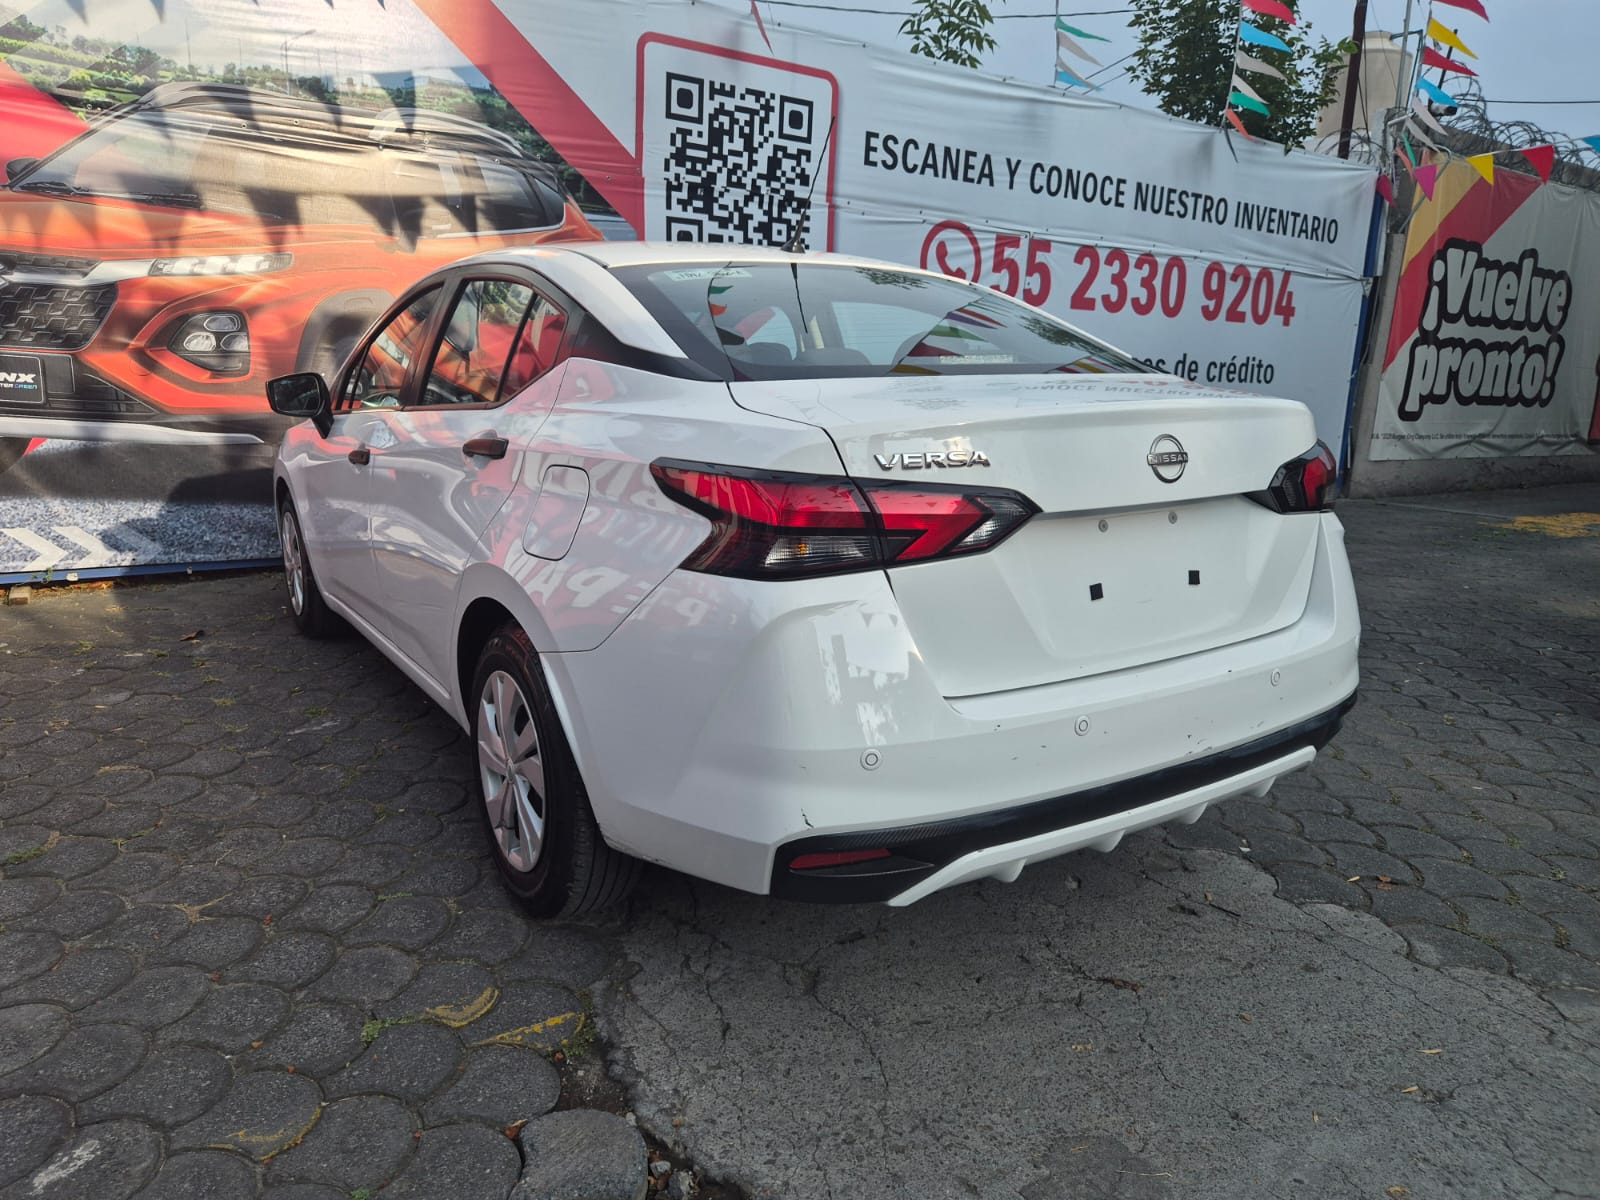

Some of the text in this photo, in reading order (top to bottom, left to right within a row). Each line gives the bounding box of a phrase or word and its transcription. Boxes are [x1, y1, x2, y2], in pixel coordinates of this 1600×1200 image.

[863, 130, 1339, 244] ESCANEA Y CONOCE NUESTRO INVENTARIO
[989, 233, 1296, 327] 55 2330 9204
[1421, 245, 1569, 332] ¡Vuelve
[1174, 352, 1199, 382] de
[1206, 355, 1275, 384] crédito
[1404, 341, 1560, 412] pronto!
[873, 450, 991, 471] VERSA
[1148, 454, 1187, 464] NISSAN
